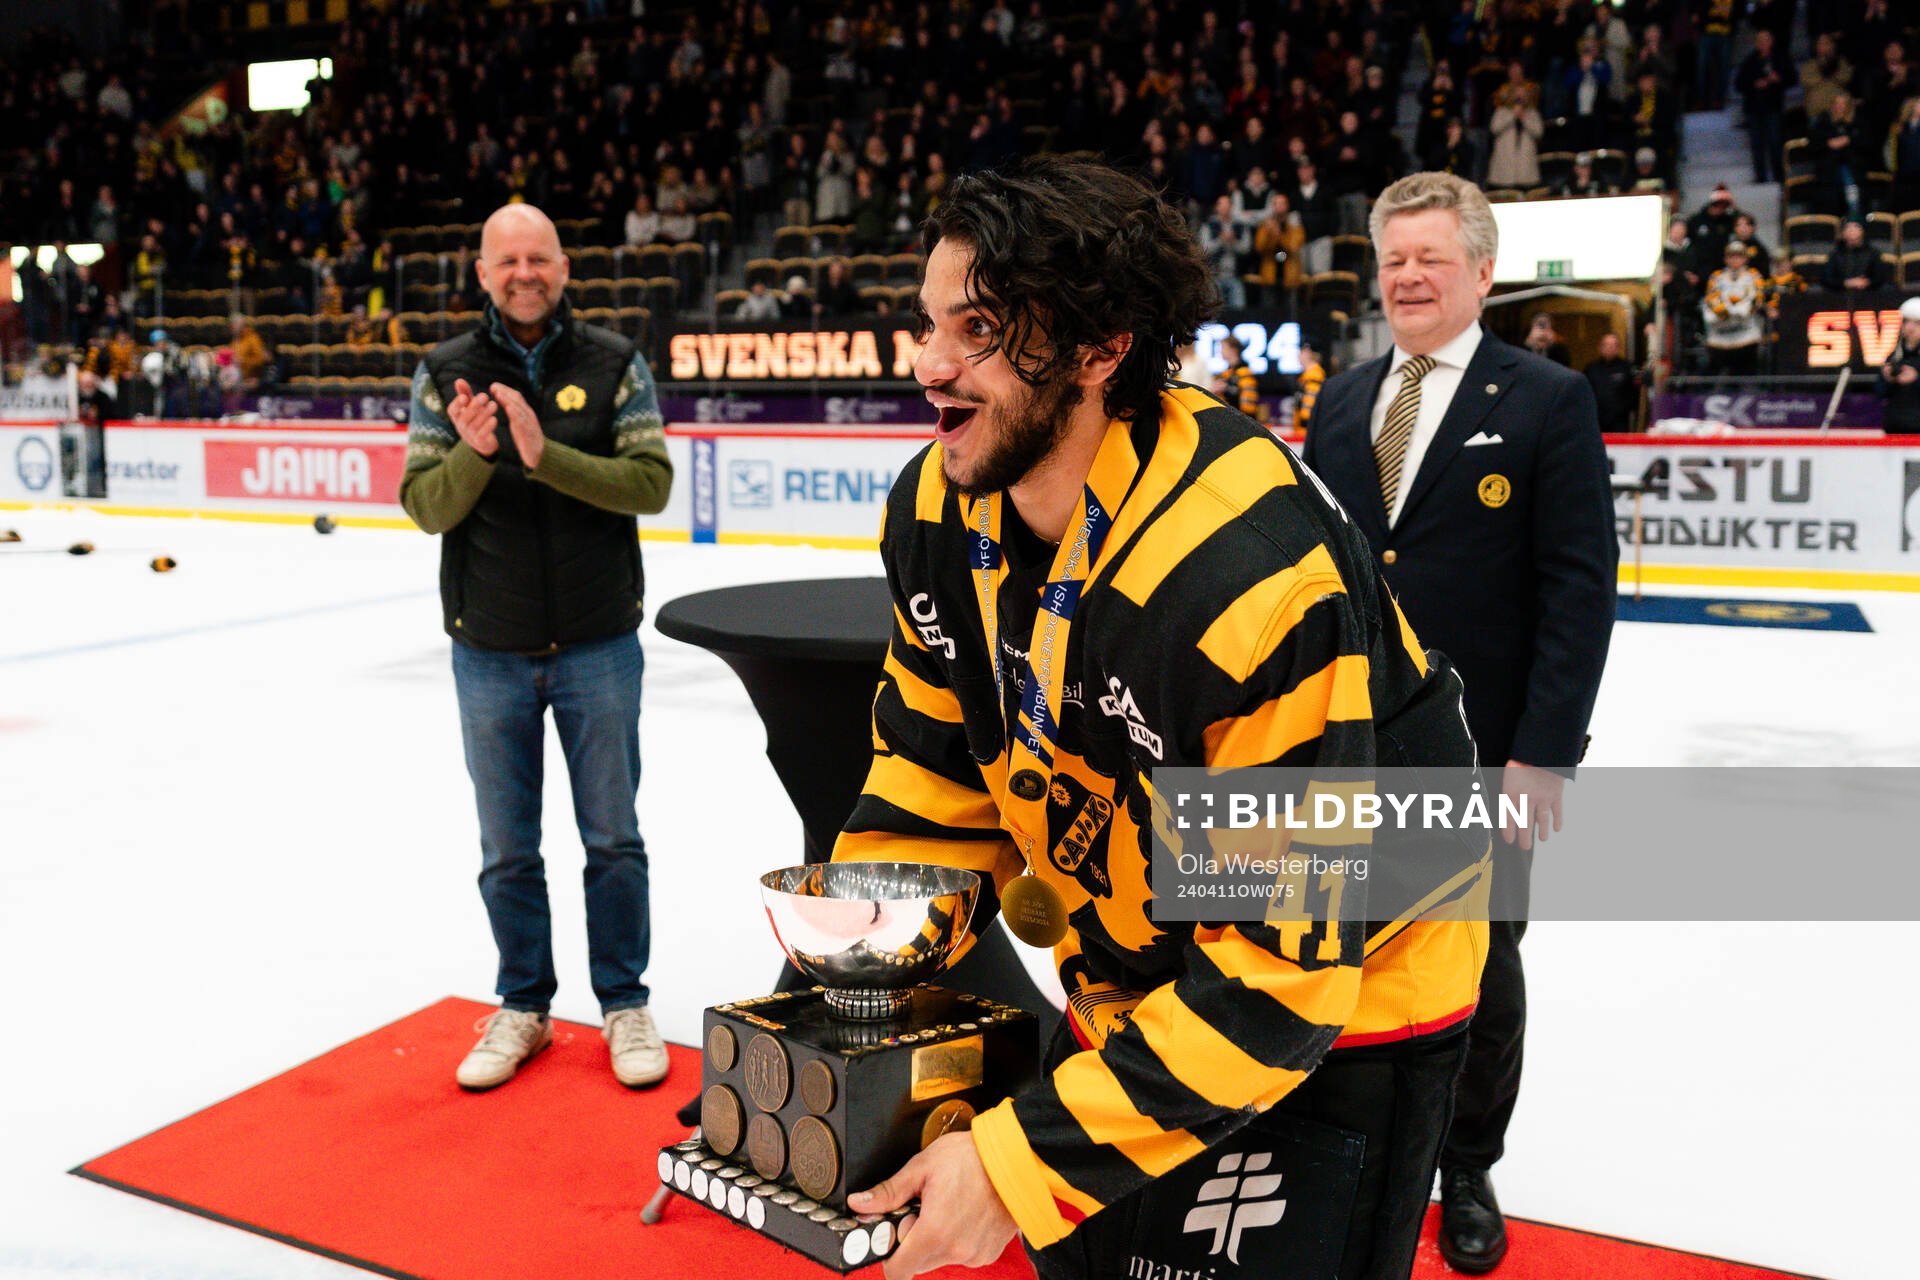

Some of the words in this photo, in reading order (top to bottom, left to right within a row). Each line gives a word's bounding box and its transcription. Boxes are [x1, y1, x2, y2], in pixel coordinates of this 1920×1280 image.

[671, 331, 882, 379] SVENSKA
[1807, 310, 1904, 368] SV
[241, 446, 372, 498] JAMA
[784, 469, 892, 503] RENH
[1061, 504, 1100, 582] SVENSKA
[1615, 517, 1858, 551] RODUKTER
[1027, 584, 1067, 758] ISHOCKEYFÖRBUNDET
[1264, 851, 1346, 962] 41
